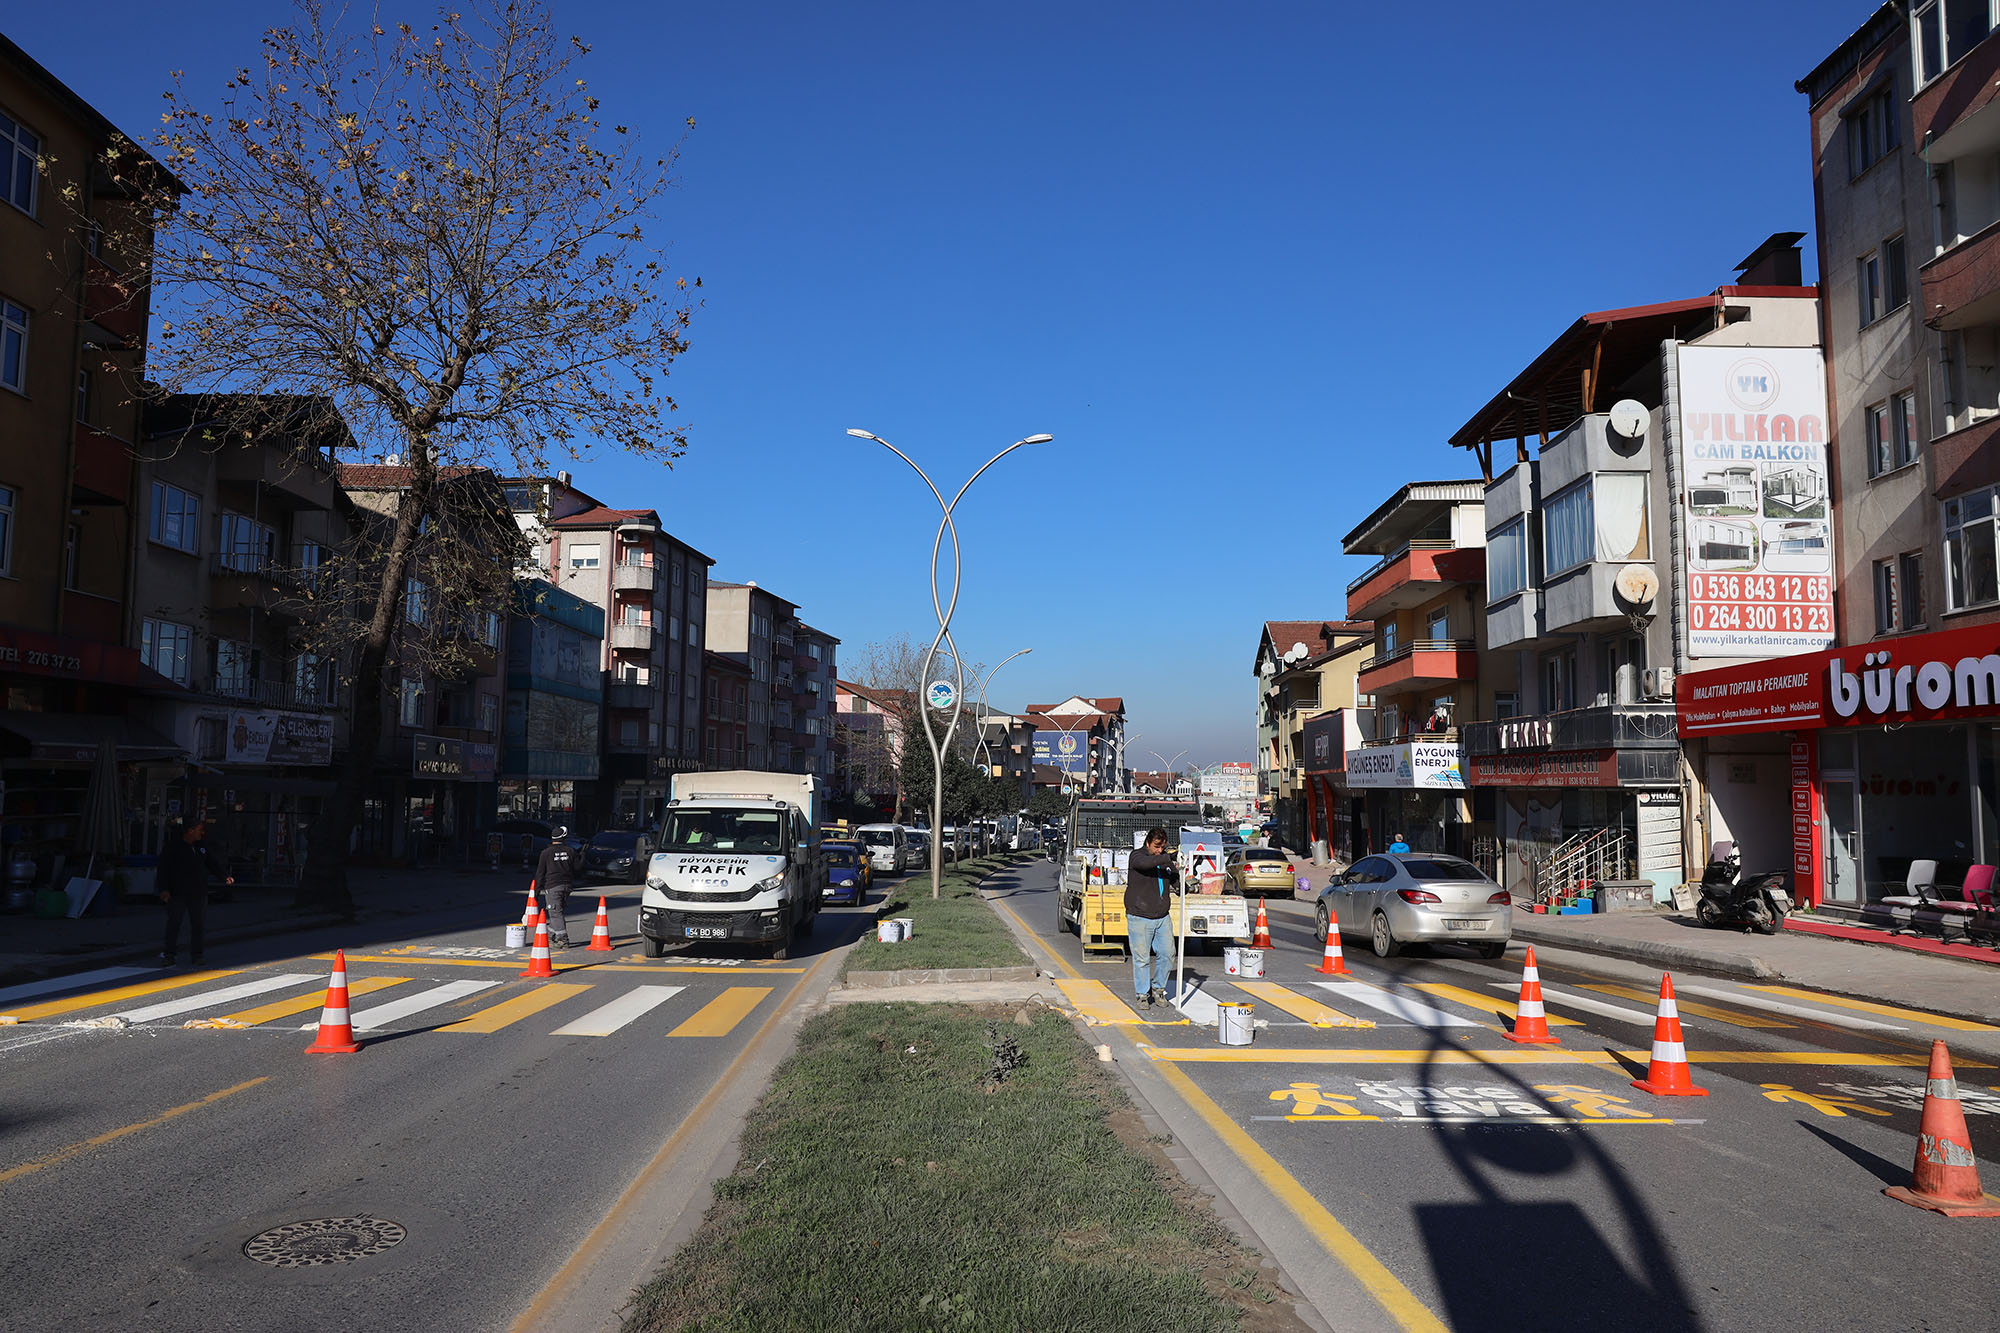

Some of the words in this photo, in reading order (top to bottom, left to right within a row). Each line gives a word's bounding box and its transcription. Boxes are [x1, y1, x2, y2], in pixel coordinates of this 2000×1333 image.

[1738, 376, 1767, 392] YK
[1686, 413, 1822, 442] YILKAR
[1694, 443, 1734, 459] CAM
[1741, 445, 1817, 460] BALKON
[1693, 576, 1703, 599] 0
[1708, 576, 1739, 599] 536
[1745, 577, 1776, 600] 843
[1781, 577, 1802, 600] 12
[1807, 578, 1828, 601] 65
[1693, 605, 1704, 628] 0
[1709, 605, 1740, 628] 264
[1745, 606, 1776, 629] 300
[1782, 606, 1803, 630] 13
[1808, 607, 1829, 631] 23
[1692, 634, 1832, 646] www.yilkarkatlanircam.com
[0, 646, 21, 662] TEL
[28, 650, 49, 667] 276
[50, 654, 65, 668] 37
[67, 657, 81, 671] 23
[1693, 684, 1728, 700] İMALATTAN
[1729, 680, 1756, 696] TOPTAN
[1756, 679, 1762, 692] &
[1763, 672, 1809, 692] PERAKENDE
[1722, 709, 1739, 720] Çalışma
[1771, 704, 1786, 715] Bahçe
[1790, 700, 1819, 712] Mobilyaları
[1347, 752, 1373, 777] AYGÜNEŞ
[1374, 750, 1396, 774] ENERJİ
[1415, 758, 1450, 767] ENERJİ
[1479, 757, 1496, 775] CAM
[1498, 755, 1536, 775] BALKON
[1537, 751, 1599, 775] SİSTEMLERİ
[678, 865, 746, 876] TRAFİK
[689, 928, 698, 936] 54
[1354, 1082, 1520, 1099] önce
[1374, 1100, 1551, 1117] yaya
